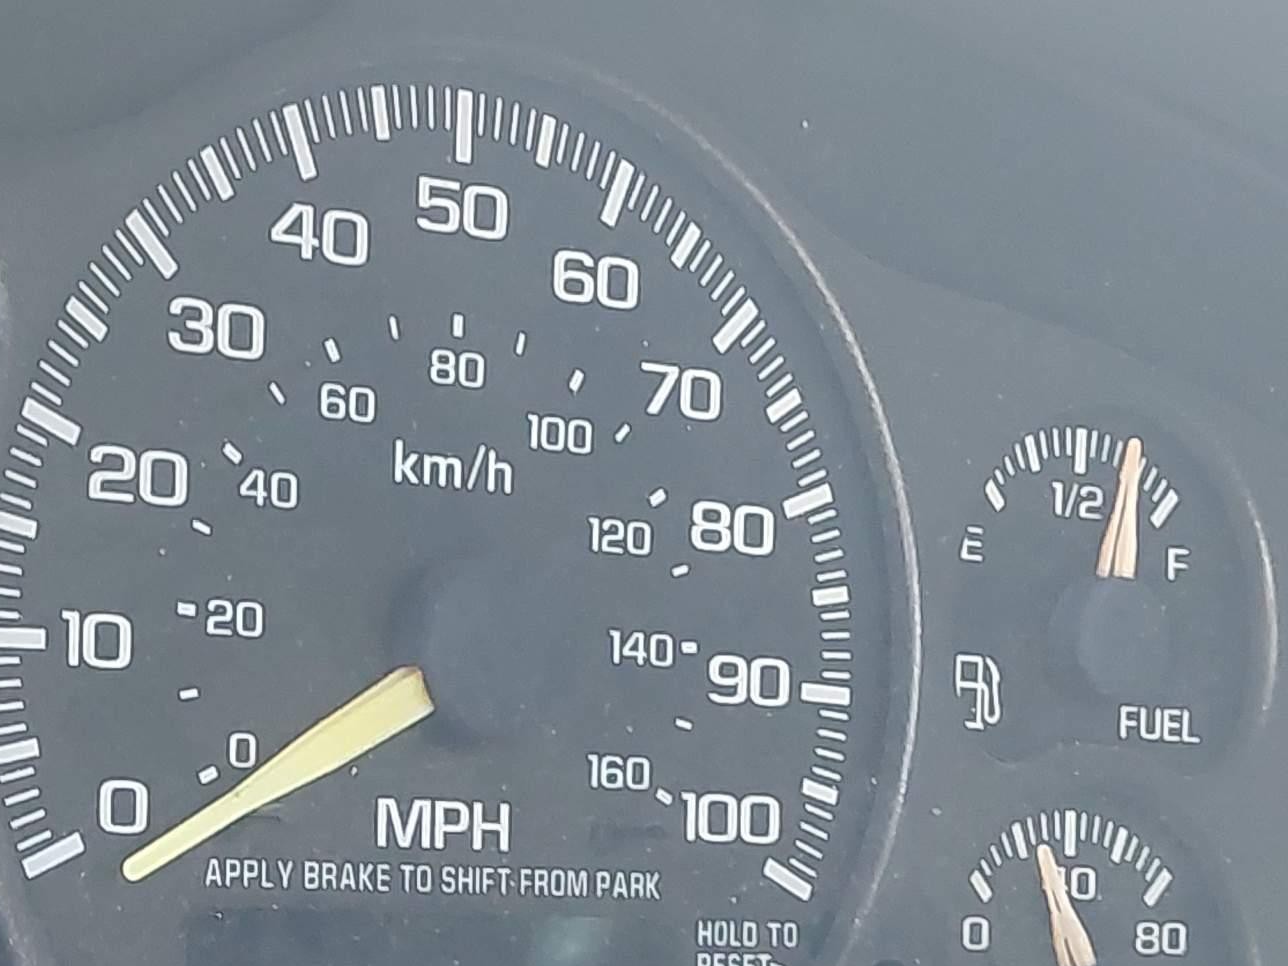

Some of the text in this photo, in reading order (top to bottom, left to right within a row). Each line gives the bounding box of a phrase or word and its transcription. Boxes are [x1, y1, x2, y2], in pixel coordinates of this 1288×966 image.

[416, 176, 509, 240] 50
[269, 203, 369, 266] 40
[552, 249, 639, 310] 60
[168, 296, 265, 360] 30
[429, 349, 485, 388] 80
[320, 382, 375, 423] 60
[640, 361, 722, 421] 70
[527, 413, 593, 454] 100
[88, 445, 188, 506] 20
[393, 438, 513, 495] km/h
[239, 469, 298, 509] 40
[1051, 482, 1103, 520] 1/2
[588, 517, 652, 556] 120
[690, 501, 775, 556] 80
[961, 526, 983, 561] E
[1168, 548, 1190, 580] F
[206, 600, 263, 637] 20
[62, 610, 132, 669] 10
[609, 629, 673, 667] 140
[706, 655, 791, 707] 90
[1119, 706, 1200, 743] FUEL
[229, 732, 257, 768] 0
[587, 754, 650, 790] 160
[99, 779, 149, 834] 0
[375, 798, 511, 852] MPH
[681, 791, 780, 844] 100
[205, 858, 660, 900] APPLY BRAKE TO SHIFT FROM PARK
[697, 920, 797, 948] HOLD TO
[962, 917, 990, 951] 0
[1135, 922, 1187, 955] 80
